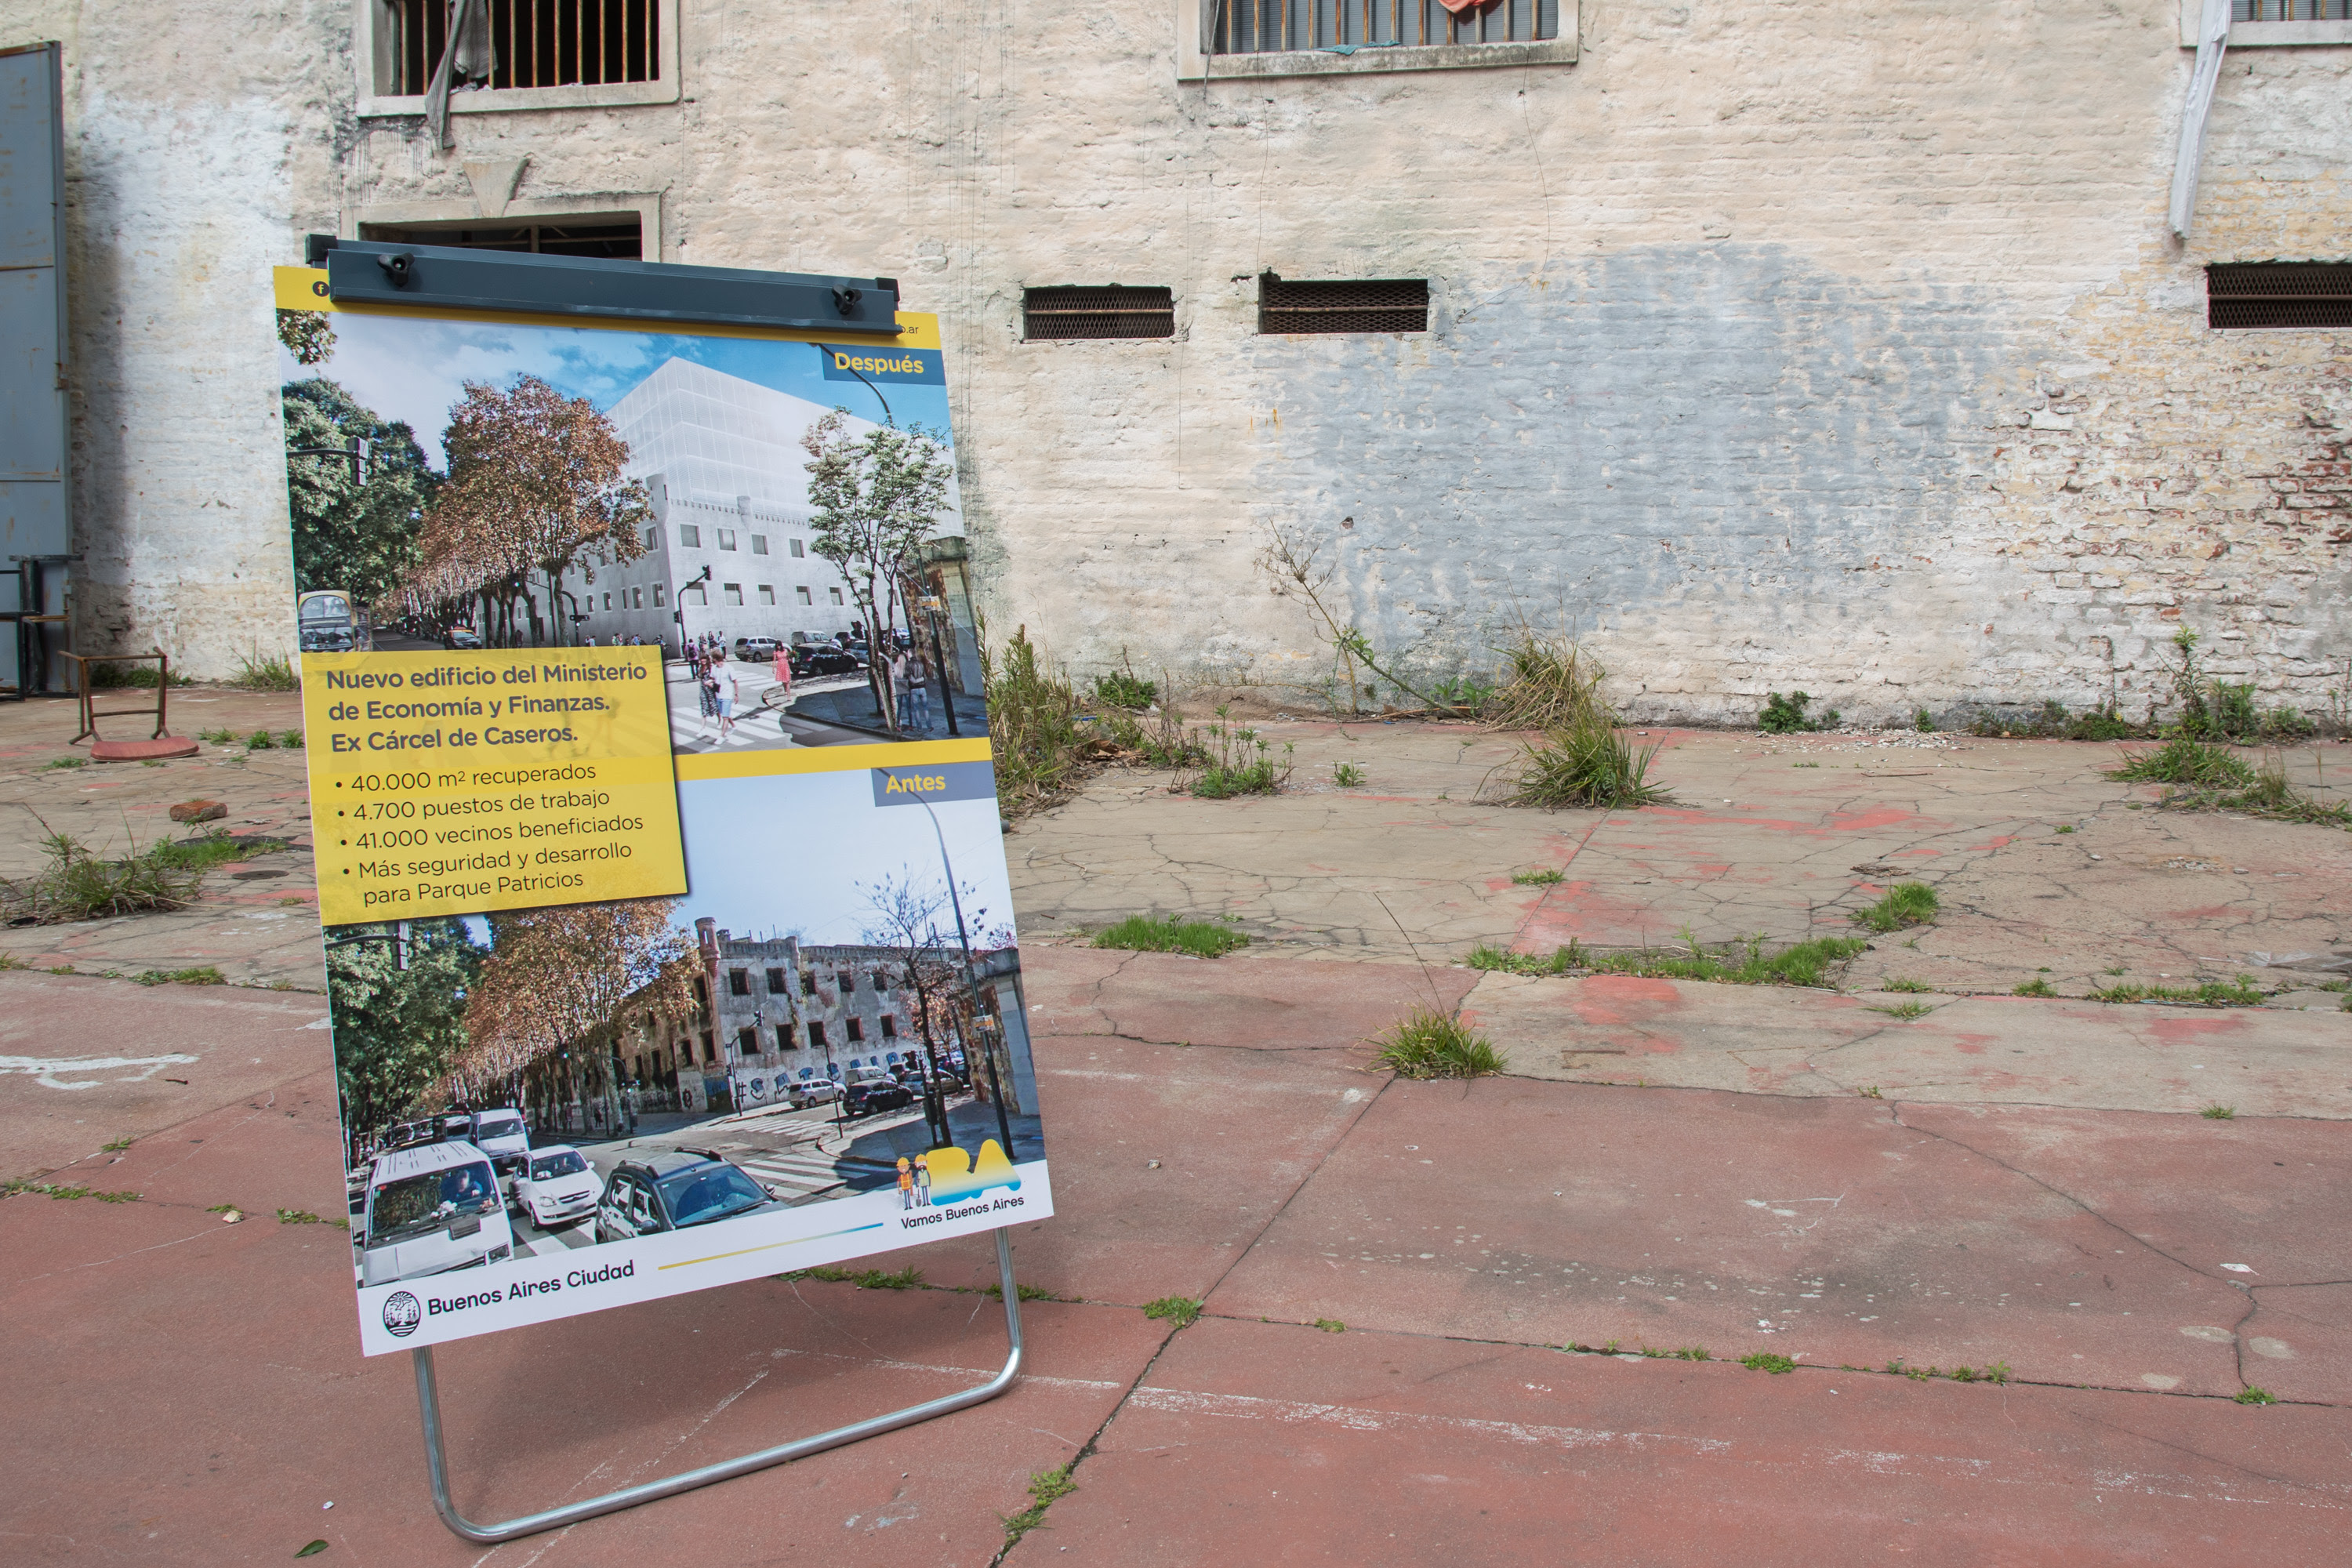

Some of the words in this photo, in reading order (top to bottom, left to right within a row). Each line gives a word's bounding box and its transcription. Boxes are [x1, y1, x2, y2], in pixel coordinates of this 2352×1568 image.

[834, 353, 924, 375] Después
[326, 670, 404, 690] Nuevo
[410, 666, 496, 688] edificio
[502, 664, 536, 684] del
[543, 662, 647, 683] Ministerio
[328, 701, 360, 721] de
[367, 696, 483, 720] Economía
[488, 700, 502, 719] y
[508, 695, 610, 714] Finanzas.
[332, 733, 361, 753] Ex
[368, 728, 441, 751] Cárcel
[448, 728, 477, 747] de
[484, 726, 578, 746] Caseros.
[351, 771, 430, 792] 40.000
[473, 763, 596, 786] recuperados
[886, 775, 946, 793] Antes
[354, 801, 416, 821] 4.700
[423, 797, 503, 820] puestos
[510, 793, 535, 811] de
[540, 790, 609, 809] trabajo
[356, 829, 428, 849] 41.000
[434, 825, 513, 844] vecinos
[519, 815, 644, 838] beneficiados
[359, 859, 401, 879] Más
[408, 850, 510, 877] seguridad
[517, 853, 528, 869] y
[535, 841, 632, 865] desarrollo
[364, 888, 411, 908] para
[418, 881, 491, 900] Parque
[498, 871, 583, 893] Patricios
[901, 1214, 942, 1229] Vamos
[946, 1203, 989, 1221] Buenos
[993, 1196, 1025, 1211] Aires
[428, 1290, 503, 1316] Buenos
[508, 1279, 561, 1301] Aires
[567, 1259, 634, 1287] Ciudad
